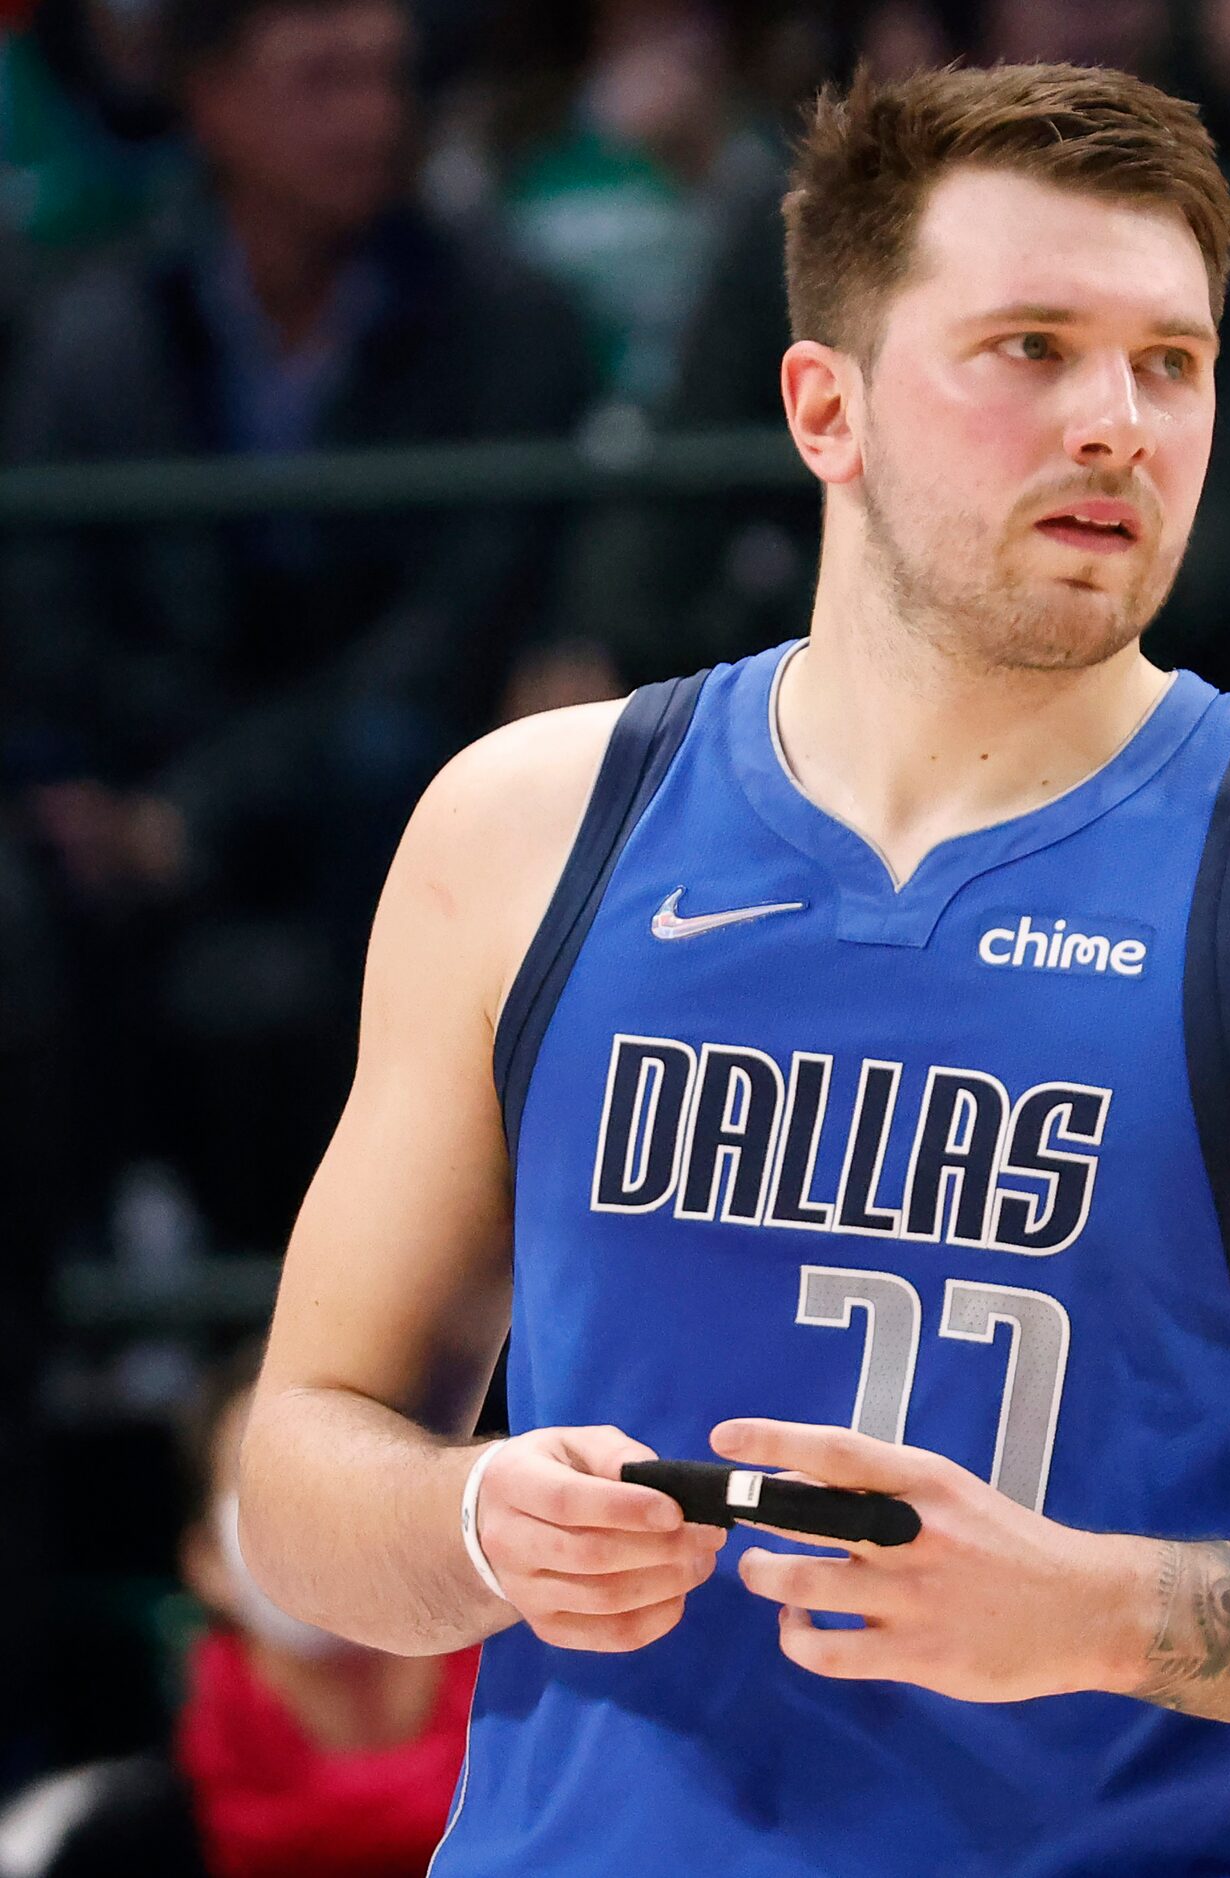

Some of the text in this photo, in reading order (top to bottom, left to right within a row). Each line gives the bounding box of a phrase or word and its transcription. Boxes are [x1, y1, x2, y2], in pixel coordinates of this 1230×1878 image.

[977, 916, 1147, 976] chime
[591, 1033, 1113, 1257] DALLAS
[795, 1264, 1071, 1517] 77
